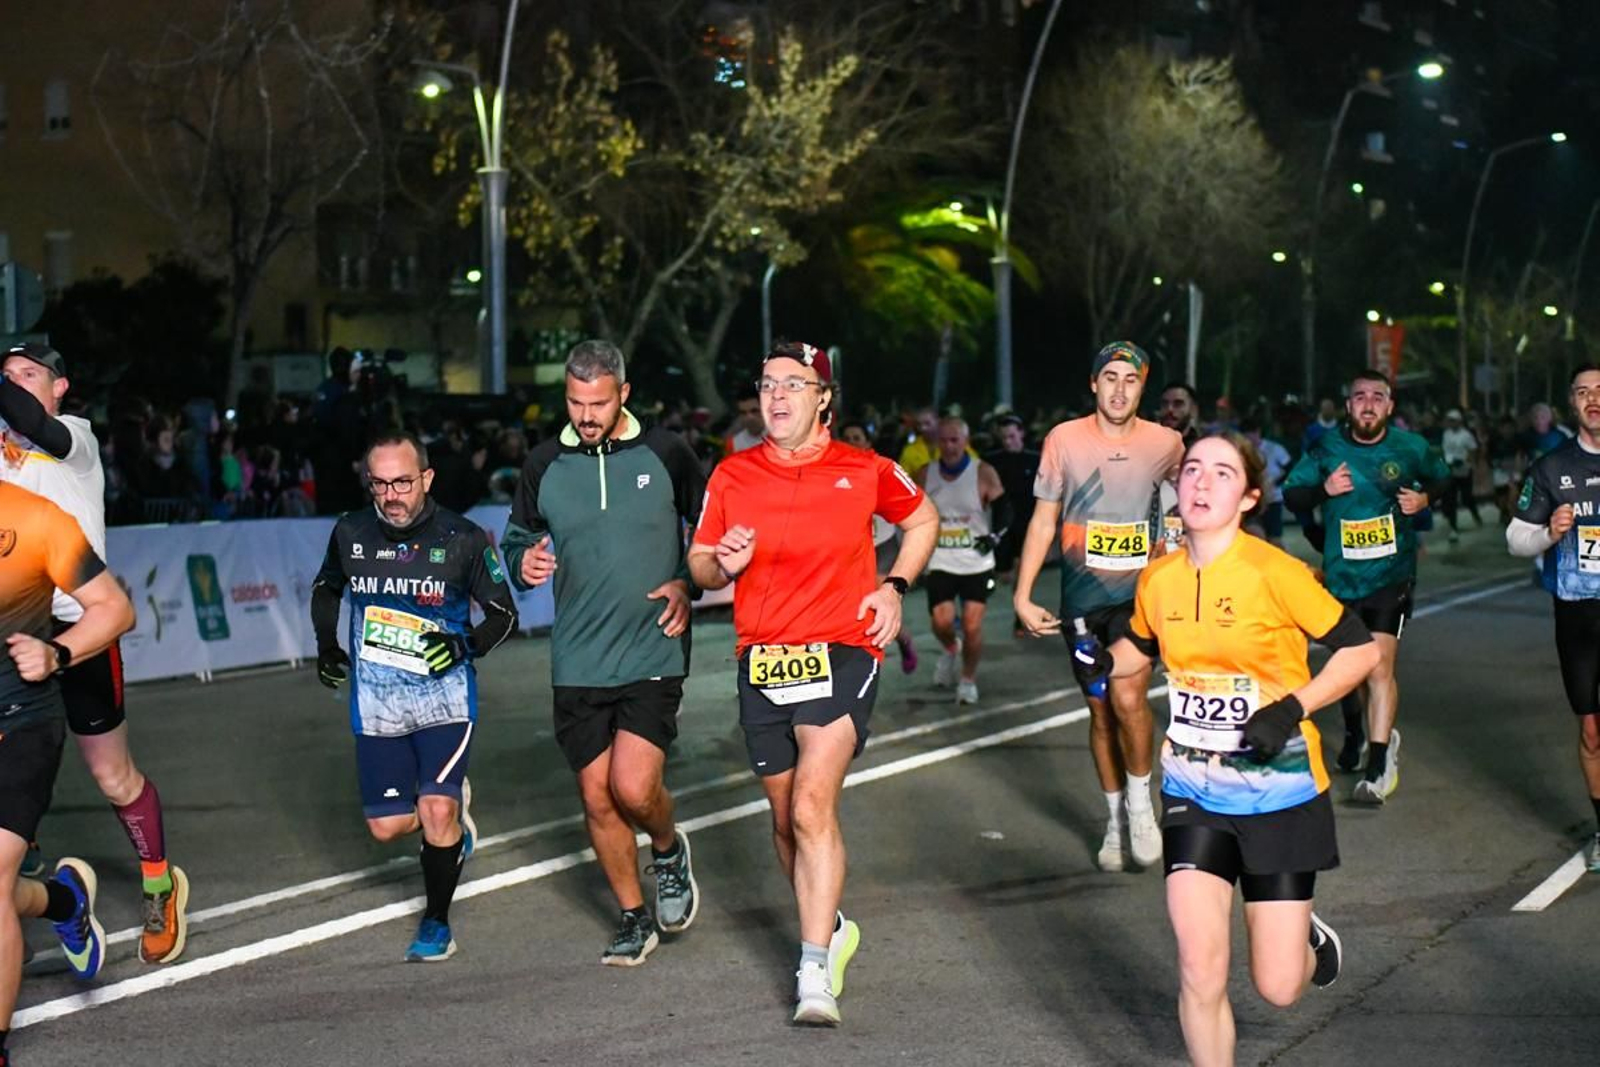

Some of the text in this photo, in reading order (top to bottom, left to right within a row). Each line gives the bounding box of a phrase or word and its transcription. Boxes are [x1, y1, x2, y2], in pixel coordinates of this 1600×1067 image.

[1573, 501, 1593, 516] AN
[1092, 535, 1143, 551] 3748
[1345, 528, 1389, 545] 3863
[1584, 540, 1600, 554] 7
[351, 576, 445, 597] SAN ANTÓN
[757, 656, 821, 682] 3409
[1178, 691, 1249, 721] 7329
